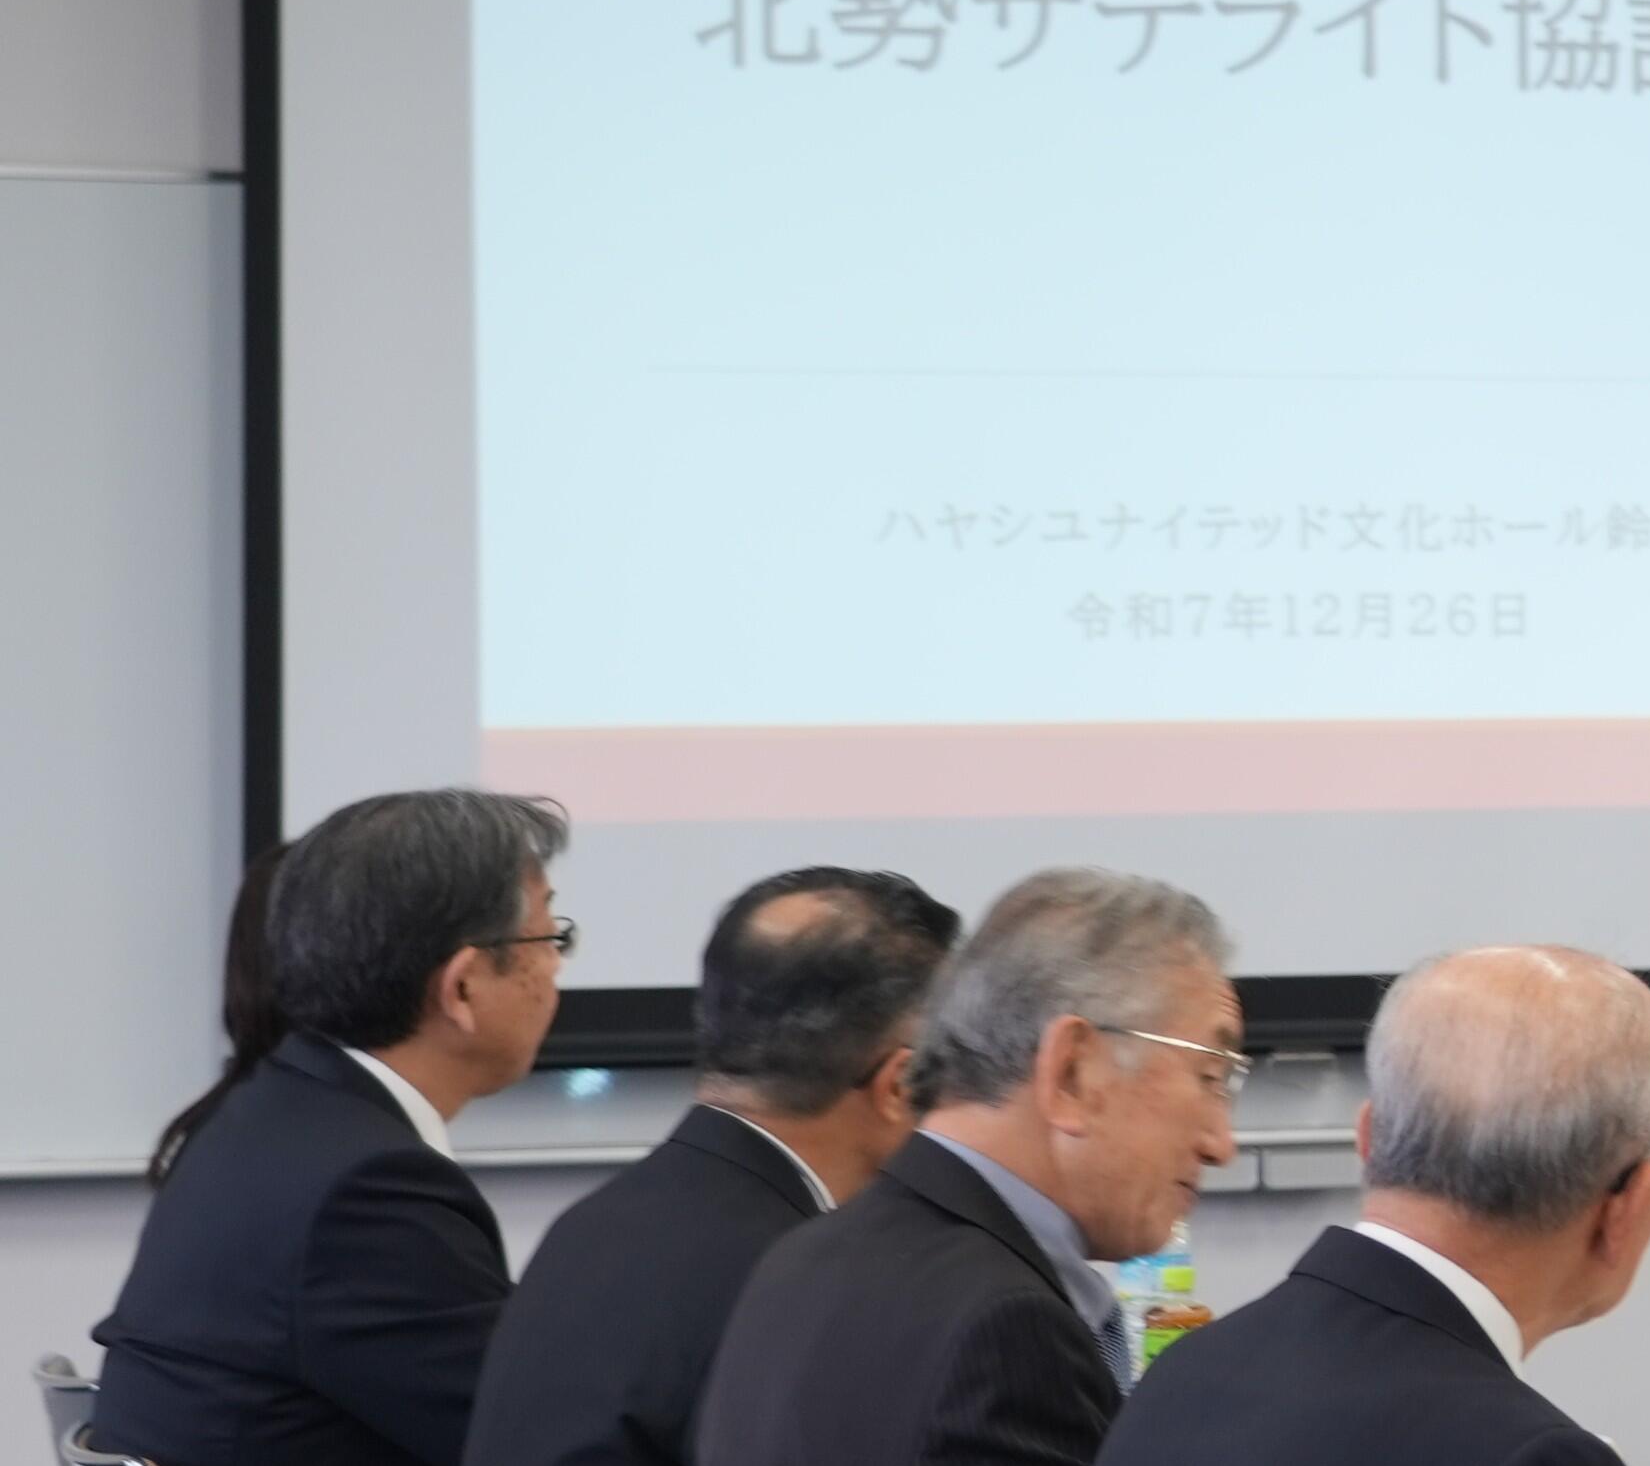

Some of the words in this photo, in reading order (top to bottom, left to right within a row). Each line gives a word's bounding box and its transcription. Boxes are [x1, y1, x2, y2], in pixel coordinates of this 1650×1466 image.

[1066, 590, 1530, 641] 令和7年12月26日
